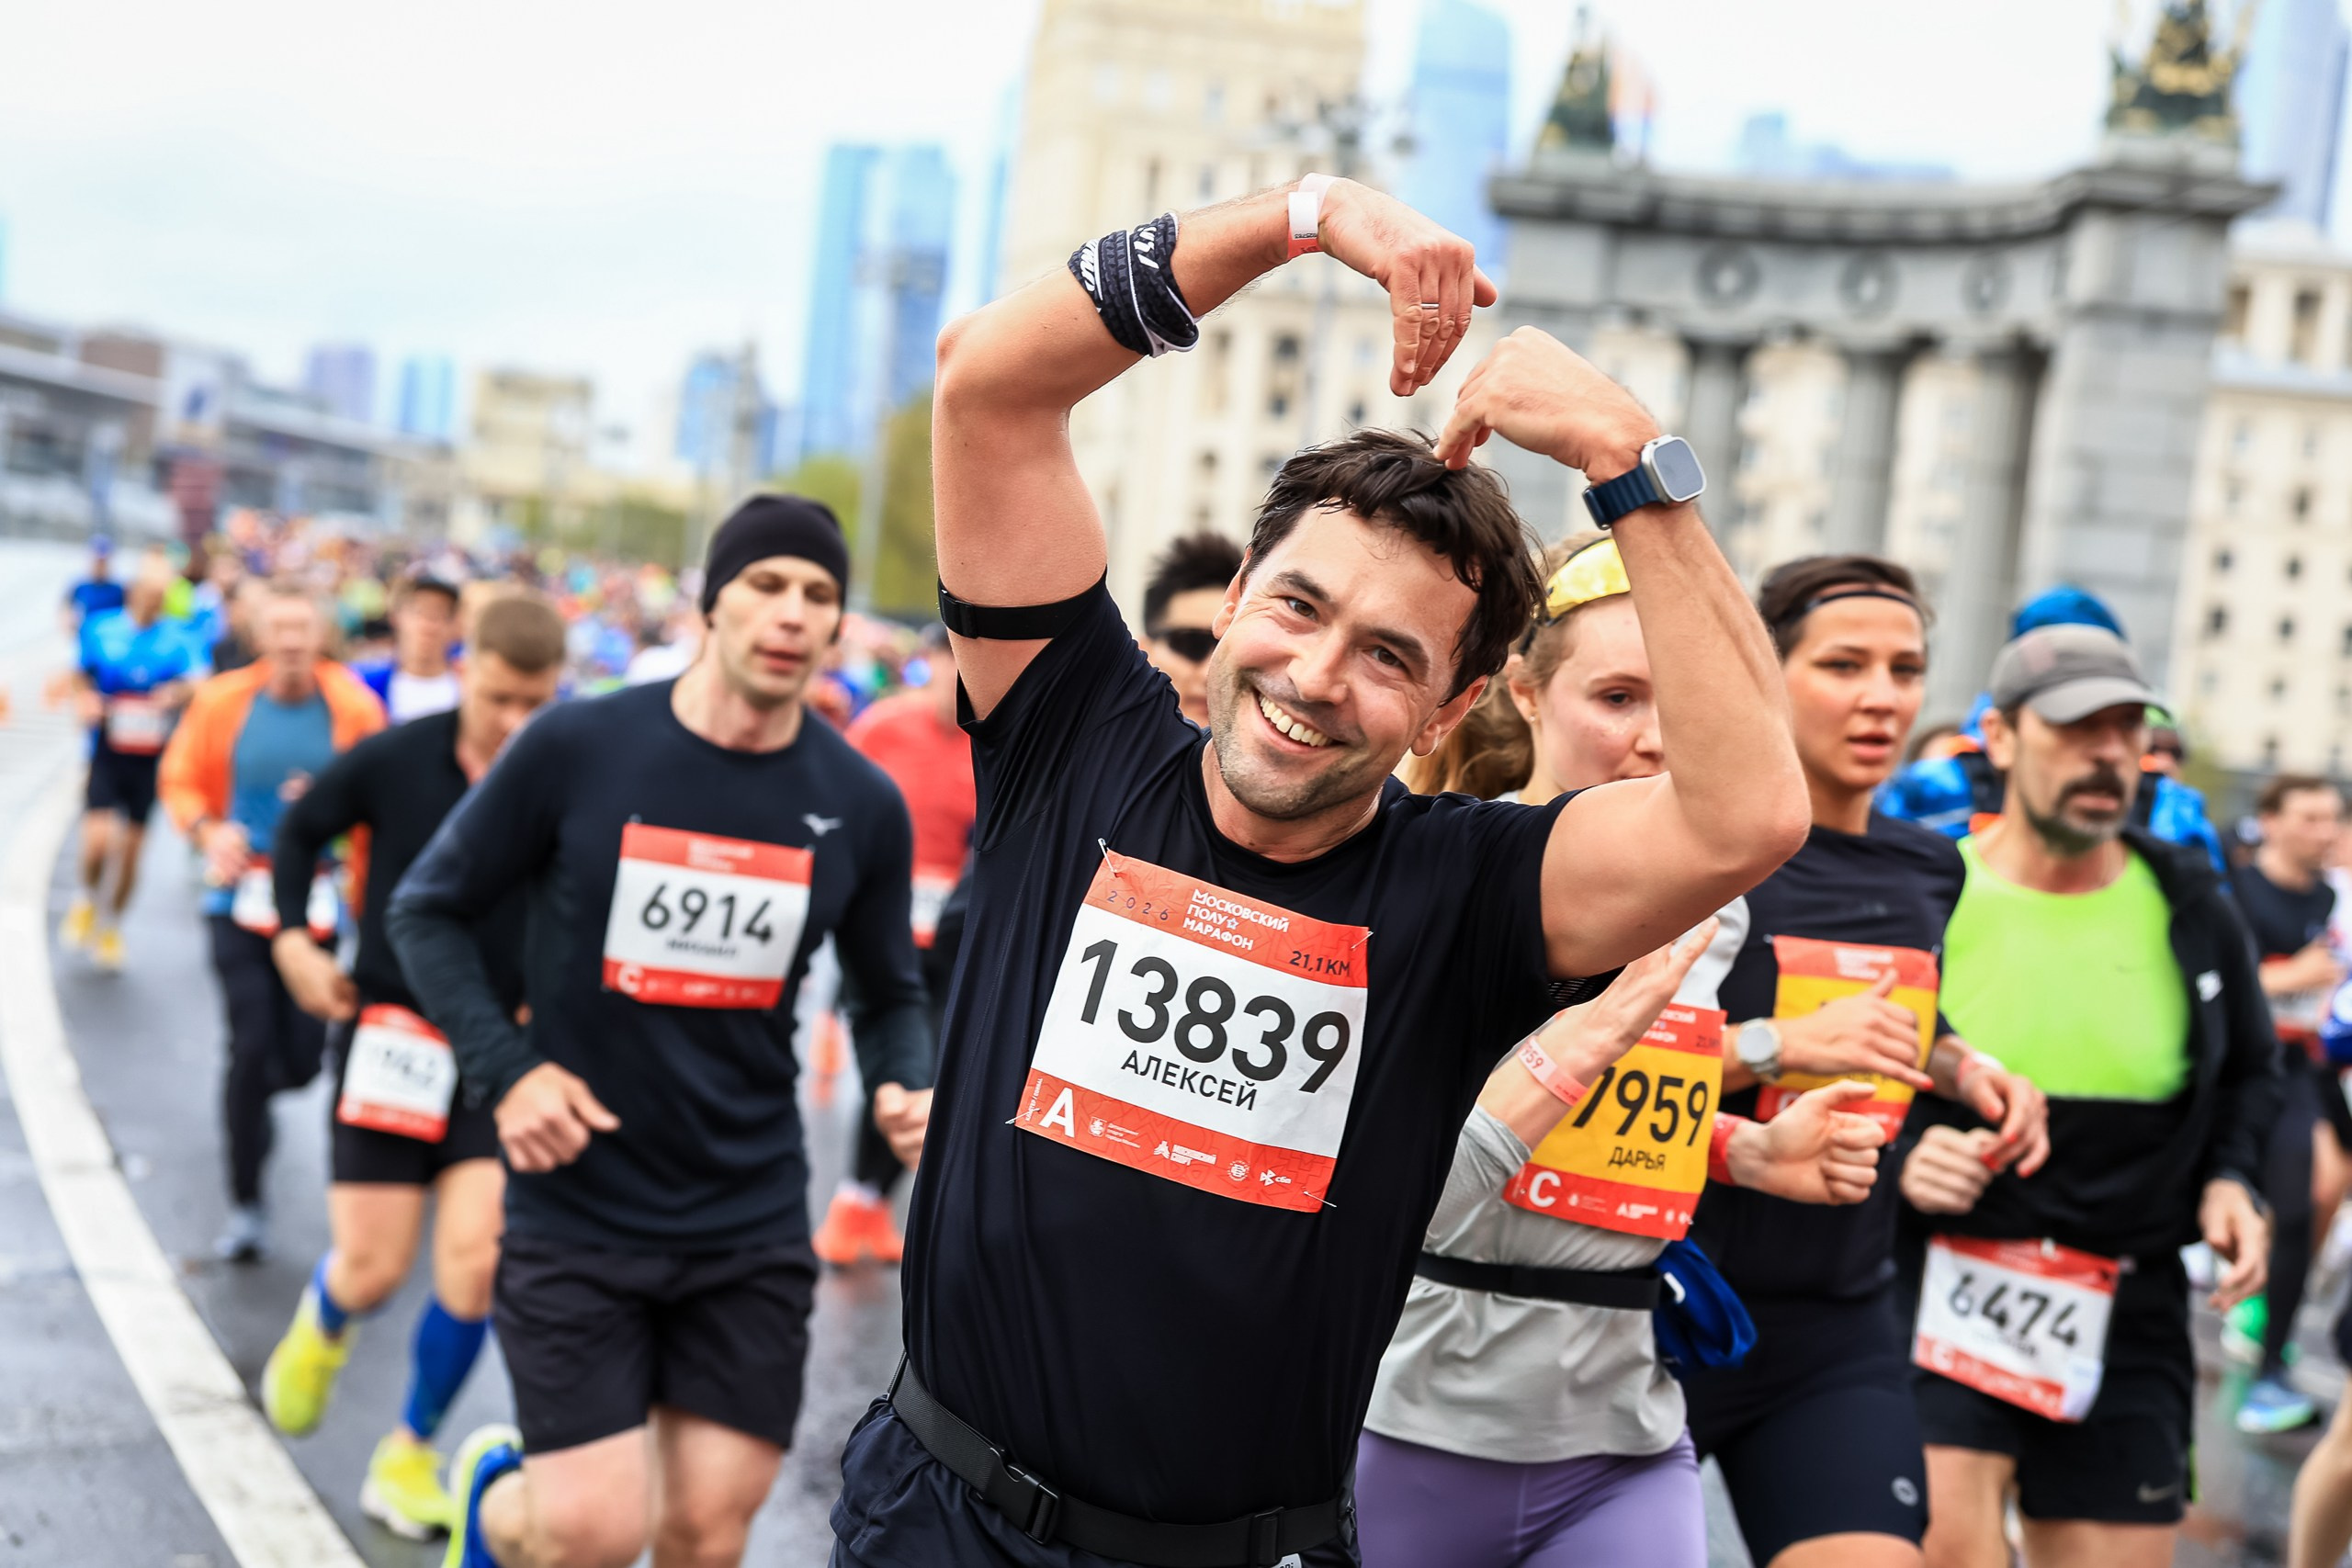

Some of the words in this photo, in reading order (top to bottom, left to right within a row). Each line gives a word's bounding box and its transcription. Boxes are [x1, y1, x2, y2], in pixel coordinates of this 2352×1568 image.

[640, 883, 775, 946] 6914
[1192, 888, 1290, 932] МОСКОВСКИЙ
[1182, 918, 1254, 951] МАРАФОН
[617, 964, 644, 994] C
[1080, 939, 1351, 1094] 13839
[1121, 1049, 1258, 1111] АЛЕКСЕЙ
[1038, 1087, 1075, 1138] A
[1608, 1146, 1666, 1171] ДАРЬЯ
[1528, 1171, 1561, 1207] C
[1948, 1273, 2079, 1348] 6474
